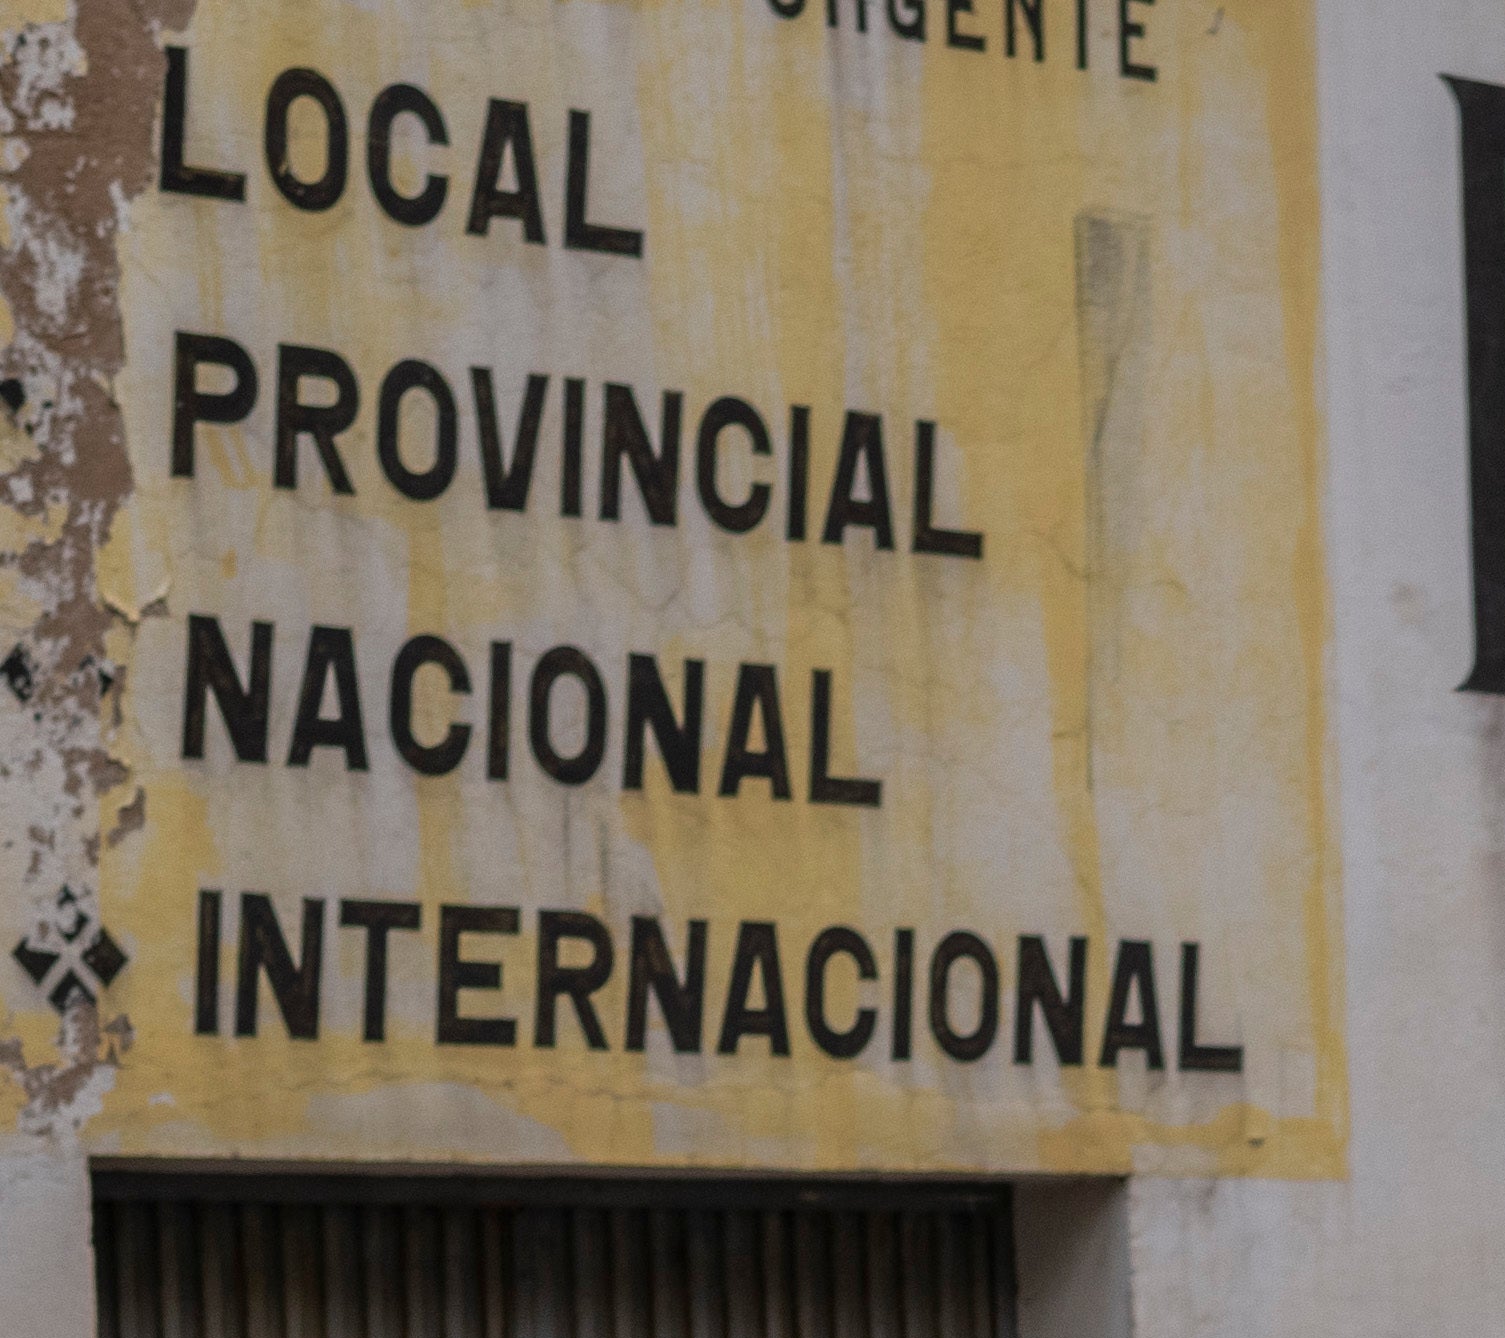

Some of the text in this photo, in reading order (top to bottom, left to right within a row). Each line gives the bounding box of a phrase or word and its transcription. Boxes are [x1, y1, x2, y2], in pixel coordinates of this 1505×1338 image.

[768, 0, 1157, 83] ENTE
[156, 43, 646, 260] LOCAL
[170, 330, 985, 561] PROVINCIAL
[180, 613, 883, 809] NACIONAL
[193, 888, 1244, 1075] INTERNACIONAL
